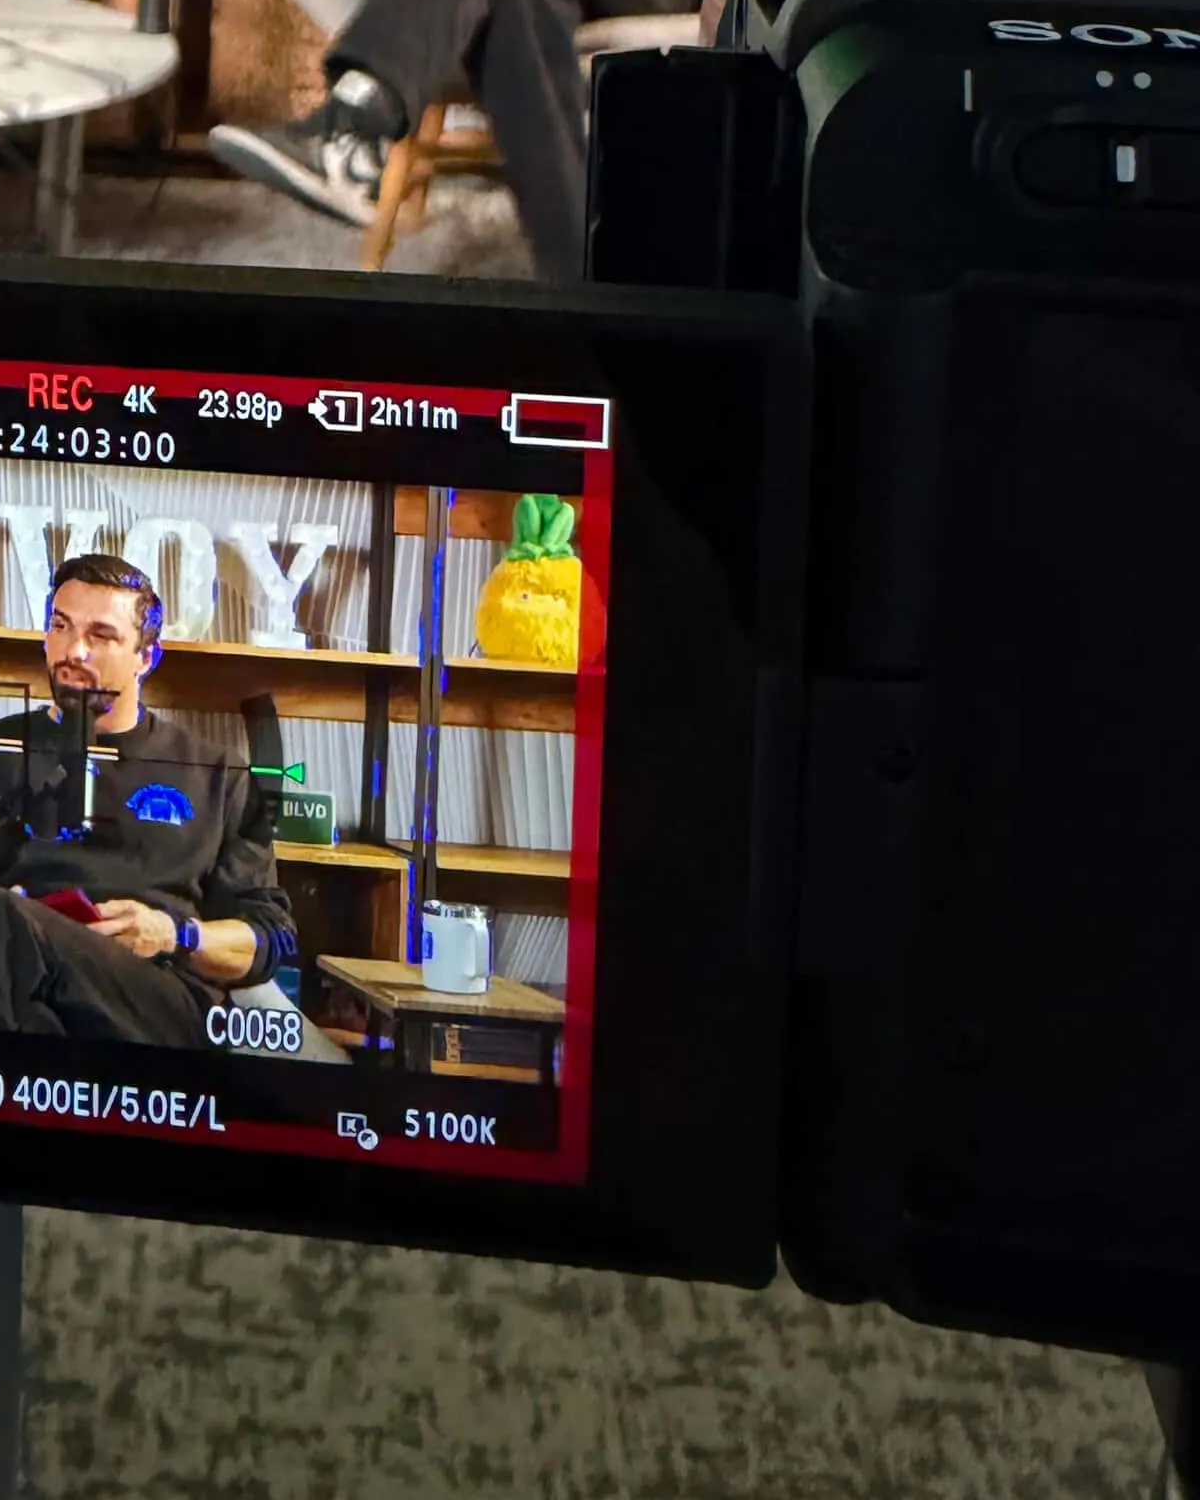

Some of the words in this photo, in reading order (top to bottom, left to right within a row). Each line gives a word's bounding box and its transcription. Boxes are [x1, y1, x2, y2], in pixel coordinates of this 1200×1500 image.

[28, 373, 94, 412] REC
[123, 384, 158, 416] 4K
[198, 389, 283, 428] 23.98p
[370, 396, 458, 431] 2h11m
[206, 1005, 302, 1053] C0058
[405, 1108, 497, 1146] 5100K
